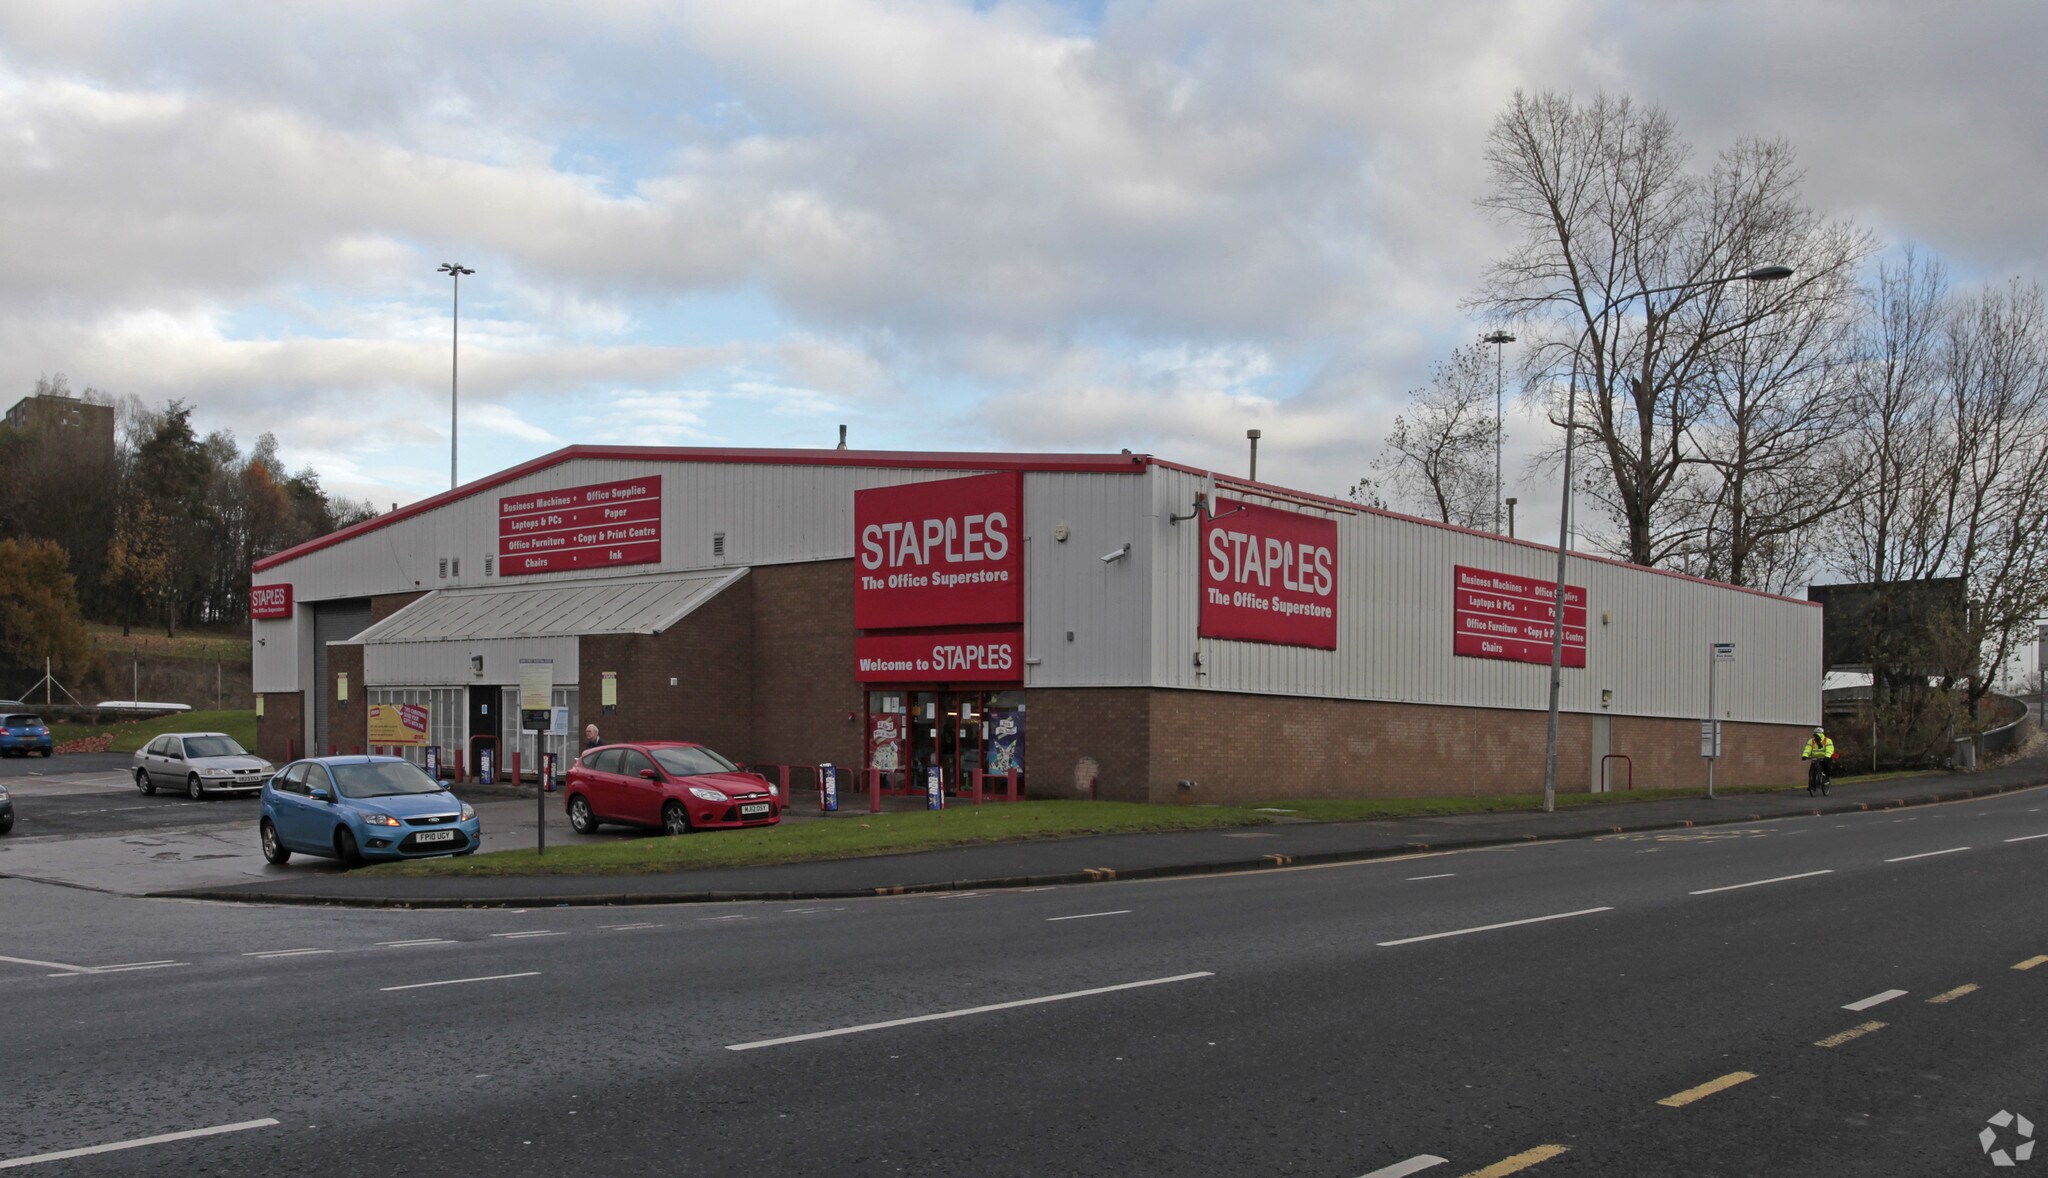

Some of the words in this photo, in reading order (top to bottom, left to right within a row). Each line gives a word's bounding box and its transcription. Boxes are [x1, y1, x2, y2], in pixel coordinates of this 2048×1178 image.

[503, 500, 535, 513] Business
[536, 496, 571, 508] Machines
[586, 489, 610, 501] Office
[611, 486, 647, 499] Supplies
[511, 519, 539, 531] Laptops
[540, 517, 546, 526] &
[548, 515, 562, 525] PCs
[604, 508, 627, 519] Paper
[508, 539, 530, 551] Office
[531, 536, 565, 548] Furniture
[578, 532, 597, 544] Copy
[599, 531, 605, 541] &
[607, 529, 627, 540] Print
[629, 526, 656, 538] Centre
[861, 512, 1009, 570] STAPLES
[525, 557, 548, 568] Chairs
[609, 550, 622, 560] Ink
[1208, 528, 1333, 597] STAPLES
[862, 576, 885, 590] The
[888, 573, 928, 589] Office
[932, 569, 1009, 588] Superstore
[1461, 573, 1491, 588] Business
[1492, 578, 1523, 593] Machines
[1534, 586, 1553, 598] Office
[252, 588, 285, 606] STAPLES
[1207, 587, 1231, 606] The
[1233, 591, 1269, 610] Office
[1272, 596, 1332, 618] Superstore
[1469, 595, 1495, 609] Laptops
[1496, 599, 1502, 610] &
[1503, 600, 1515, 611] PCs
[1466, 618, 1487, 630] Office
[1488, 620, 1518, 634] Furniture
[1527, 626, 1543, 639] Copy
[1544, 628, 1549, 638] &
[1565, 631, 1584, 643] Centre
[859, 658, 913, 672] Welcome
[916, 658, 929, 671] to
[932, 644, 1012, 670] STAPLES
[1481, 641, 1503, 653] Chairs
[420, 833, 436, 841] FP10
